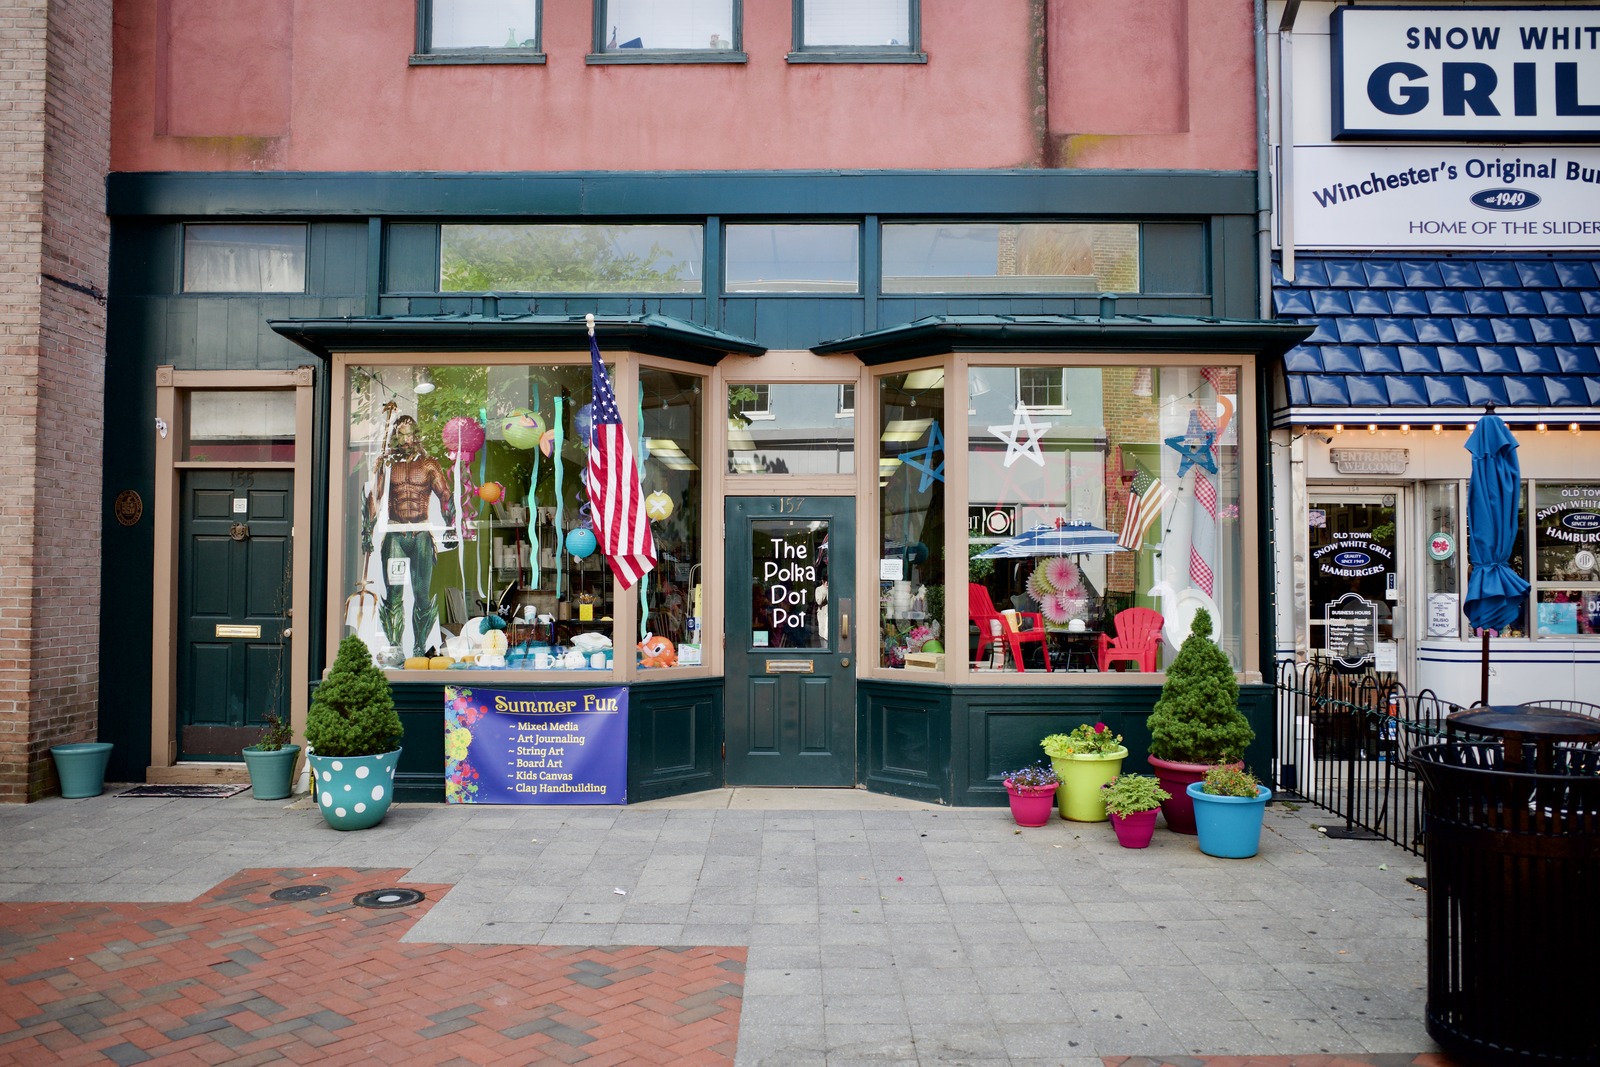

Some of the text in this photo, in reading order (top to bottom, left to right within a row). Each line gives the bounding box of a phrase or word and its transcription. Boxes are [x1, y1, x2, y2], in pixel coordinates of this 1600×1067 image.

[1406, 26, 1500, 50] SNOW
[1366, 62, 1600, 116] GRIL
[1312, 161, 1458, 208] Winchester's
[1465, 158, 1556, 184] Original
[1496, 192, 1526, 206] 1949
[1409, 221, 1600, 234] HOME OF THE SLIDER
[1340, 452, 1403, 462] ENTRANCE
[230, 471, 255, 488] 155
[780, 497, 805, 513] 157
[1536, 502, 1567, 520] SNOW
[770, 538, 808, 559] The
[1313, 543, 1339, 559] SNOW
[1369, 544, 1392, 559] GRILL
[764, 562, 816, 582] Polka
[1321, 564, 1385, 577] HAMBURGERS
[771, 585, 808, 605] Dot
[773, 608, 806, 628] Pot
[495, 694, 618, 713] Summer Fun
[518, 722, 579, 731] Mixed Media
[517, 734, 585, 746] Art Journaling
[517, 747, 564, 758] String Art
[516, 759, 563, 768] Board Art
[516, 771, 573, 780] Kids Canvas
[515, 784, 607, 794] Clay Handbuilding
